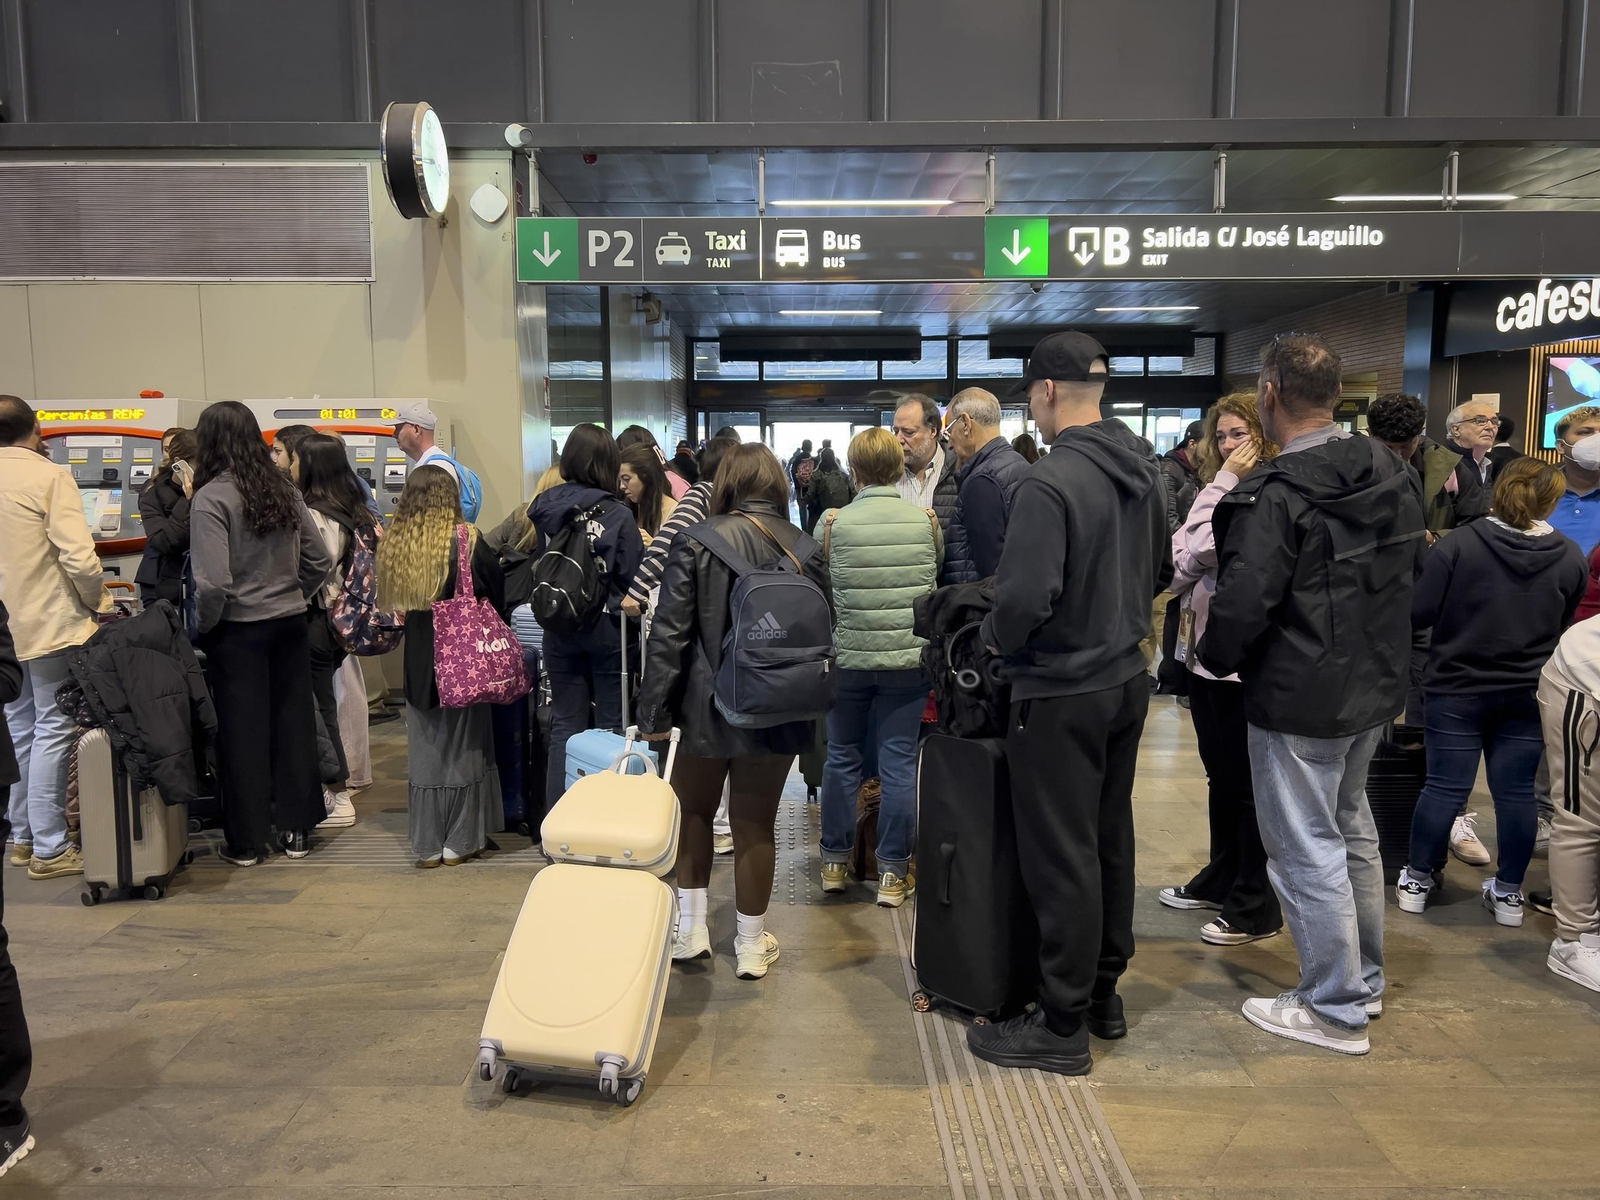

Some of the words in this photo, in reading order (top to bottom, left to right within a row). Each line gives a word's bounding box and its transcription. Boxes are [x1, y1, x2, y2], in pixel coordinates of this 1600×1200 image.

[704, 229, 747, 251] Taxi
[822, 230, 862, 251] Bus
[1142, 225, 1211, 249] Salida
[1216, 226, 1238, 248] C/
[1241, 224, 1291, 248] José
[1296, 224, 1384, 251] Laguillo
[588, 229, 635, 267] P2
[1103, 227, 1131, 267] B
[705, 257, 731, 268] TAXI
[822, 256, 846, 268] BUS
[1142, 254, 1169, 267] EXIT
[36, 409, 108, 422] Cercanías
[747, 629, 788, 640] adidas
